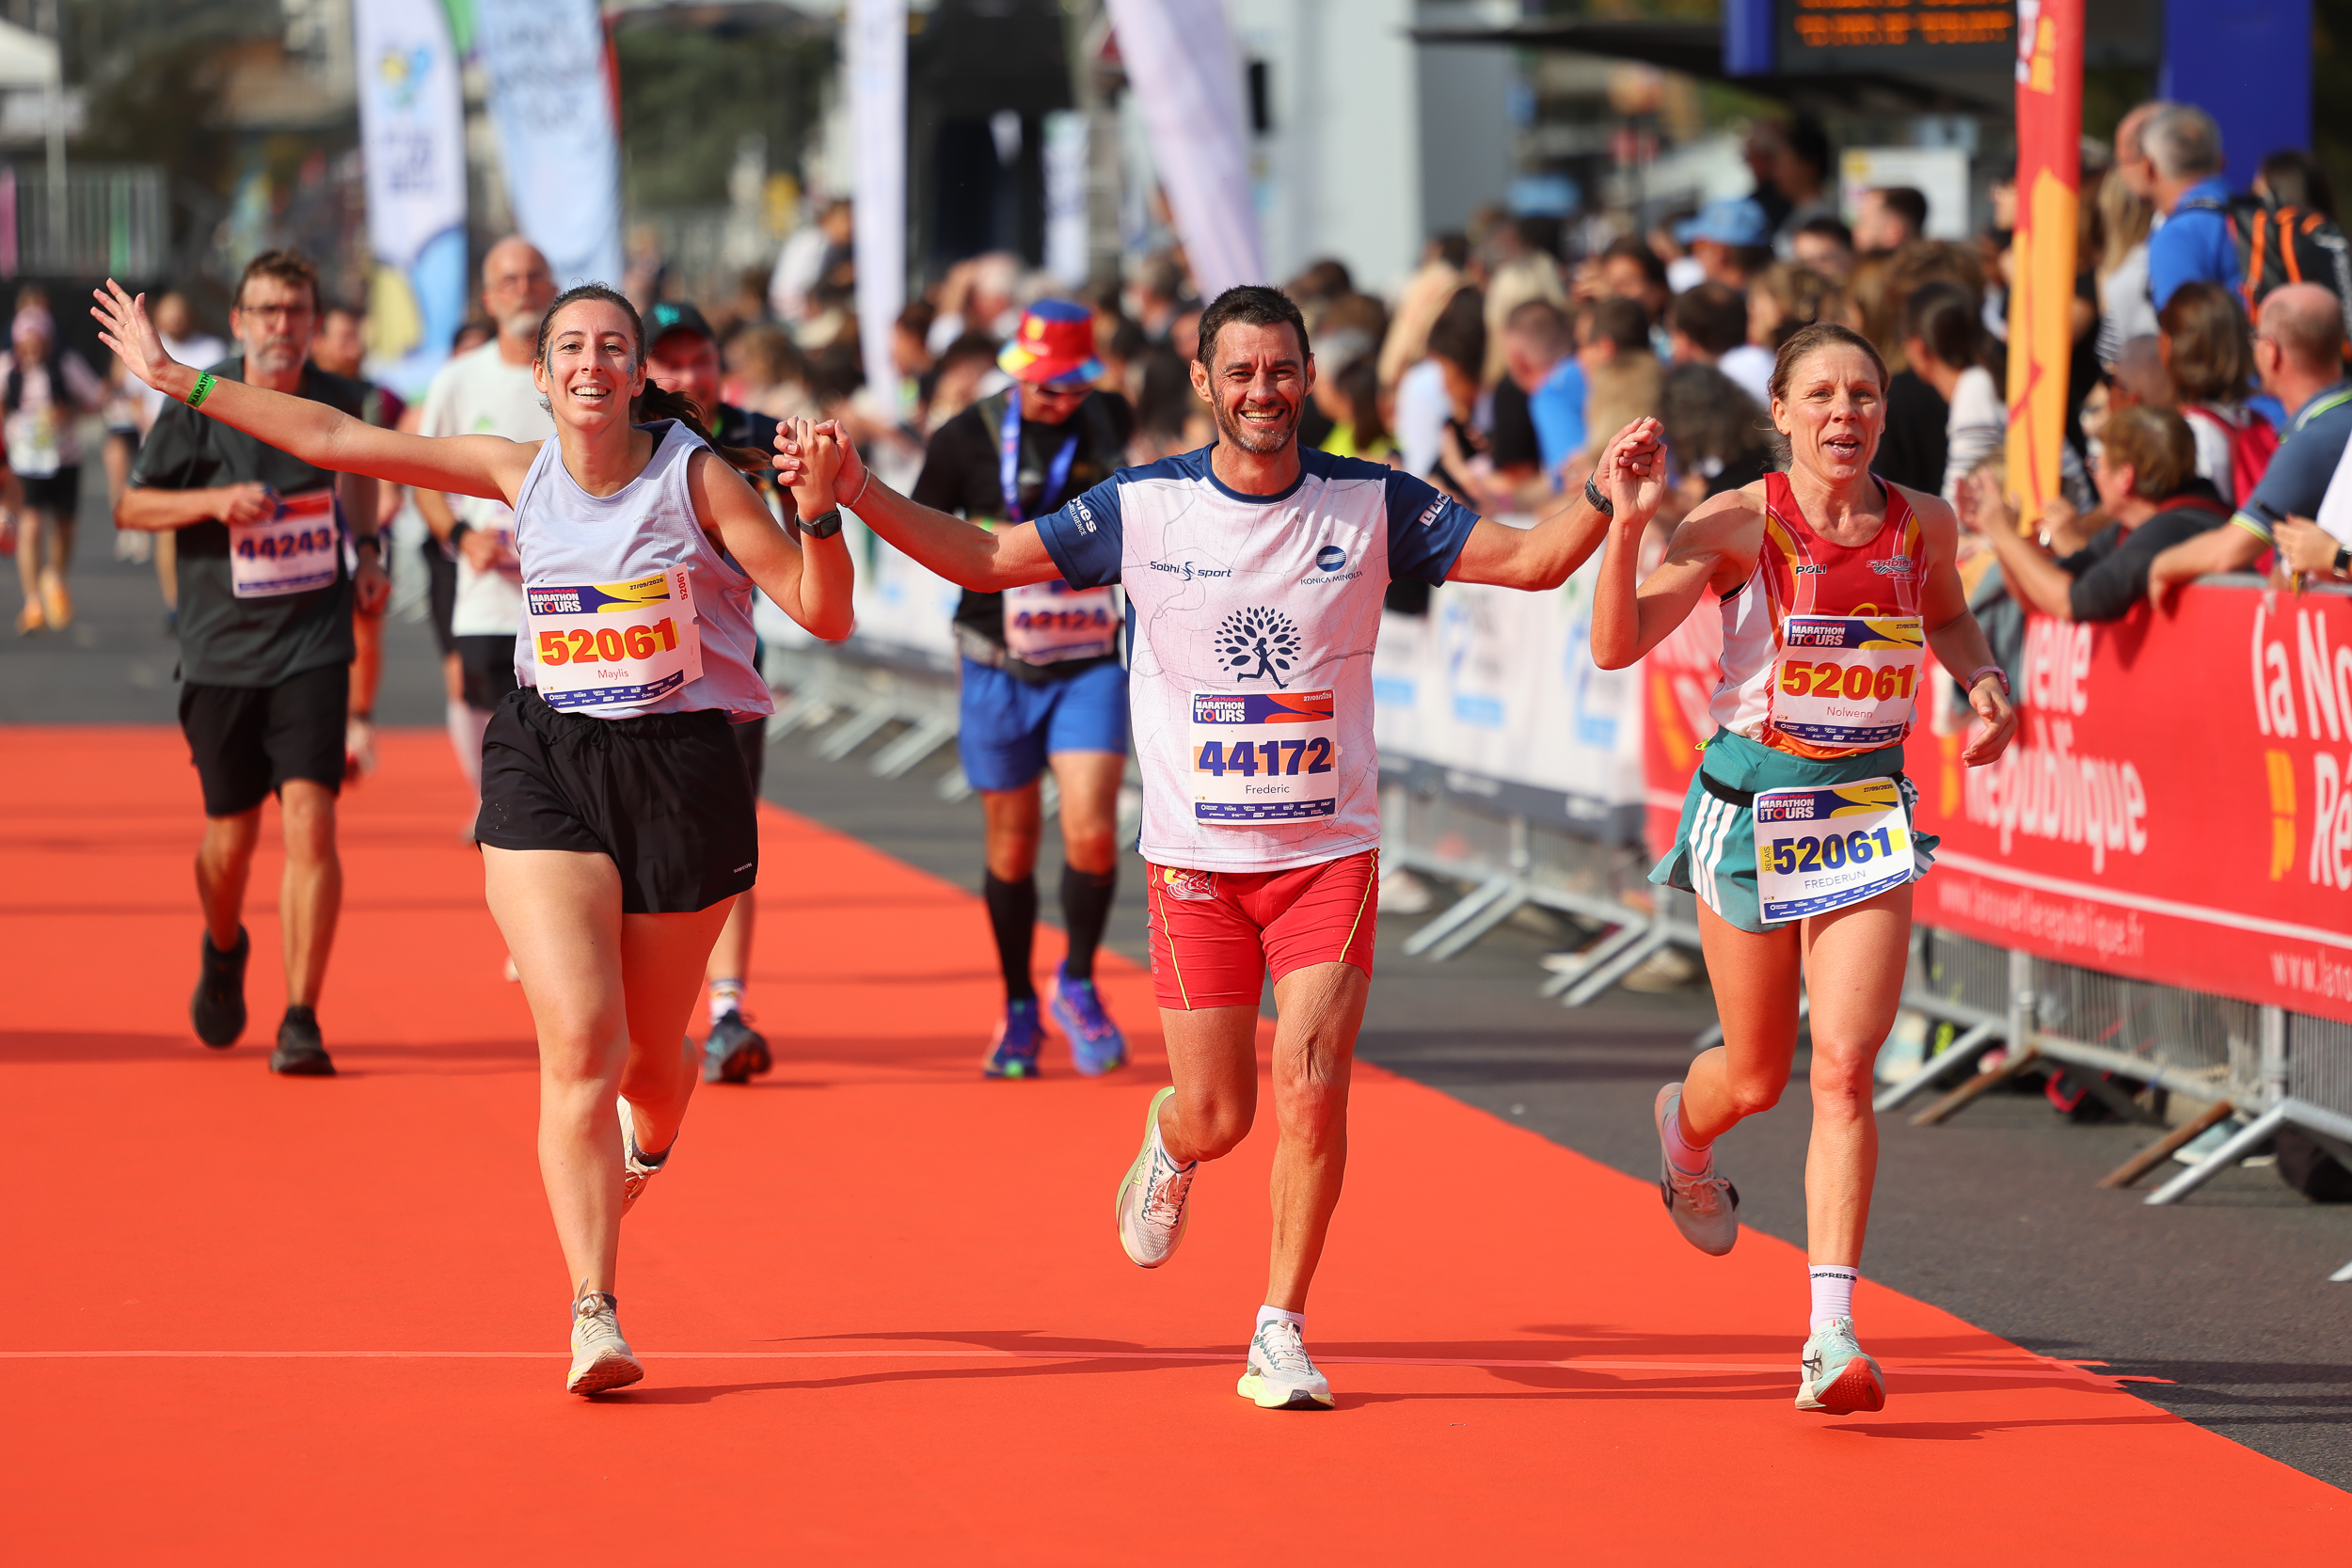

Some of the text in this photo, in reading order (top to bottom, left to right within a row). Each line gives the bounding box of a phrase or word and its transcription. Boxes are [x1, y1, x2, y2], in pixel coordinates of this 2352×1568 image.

[239, 528, 331, 560] 44243
[1150, 561, 1232, 578] Sobhi sport
[1795, 564, 1827, 575] POLI
[1300, 571, 1363, 585] KONICA MINOLTA
[676, 572, 688, 600] 52061
[530, 594, 580, 602] MARATHON
[535, 601, 582, 613] TOURS
[1791, 626, 1846, 635] MARATHON
[539, 617, 676, 666] 52061
[1796, 634, 1844, 645] TOURS
[597, 668, 629, 681] Maylis
[2250, 603, 2298, 738] la
[1783, 660, 1915, 702] 52061
[1195, 701, 1245, 710] MARATHON
[1826, 706, 1873, 719] Nolwenn
[1195, 708, 1246, 722] TOURS
[1199, 736, 1331, 777] 44172
[1246, 784, 1290, 794] Frederic
[1759, 799, 1815, 808] MARATHON
[1765, 807, 1815, 820] TOURS
[1772, 827, 1892, 875] 52061
[1763, 847, 1772, 872] RELAIS
[1804, 870, 1867, 890] FREDERUN
